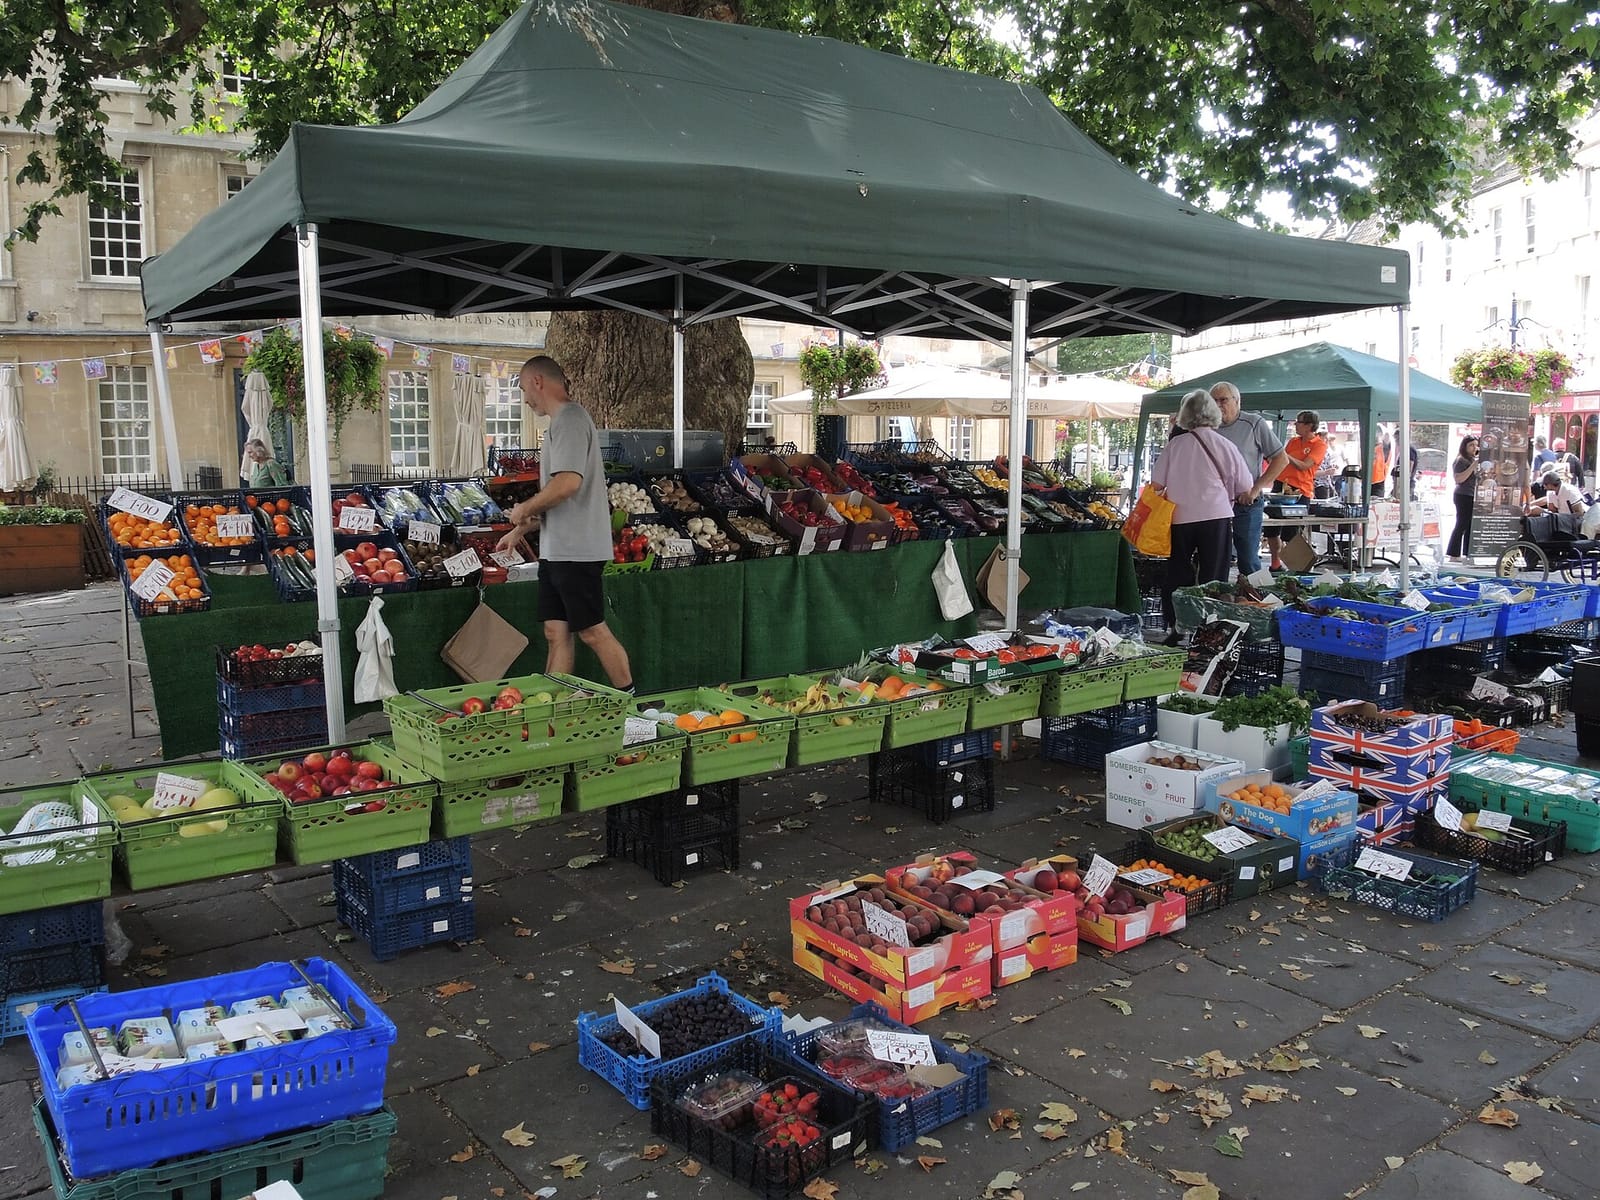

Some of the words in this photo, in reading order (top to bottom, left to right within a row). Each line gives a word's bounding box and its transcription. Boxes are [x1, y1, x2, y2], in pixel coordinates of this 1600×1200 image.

[881, 402, 912, 410] PIZZERIA
[988, 667, 1006, 677] Baron
[1110, 760, 1147, 774] SOMERSET
[1108, 792, 1146, 807] SOMERSET
[1165, 793, 1186, 804] FRUIT
[1243, 807, 1257, 818] The
[1259, 811, 1274, 825] Dog
